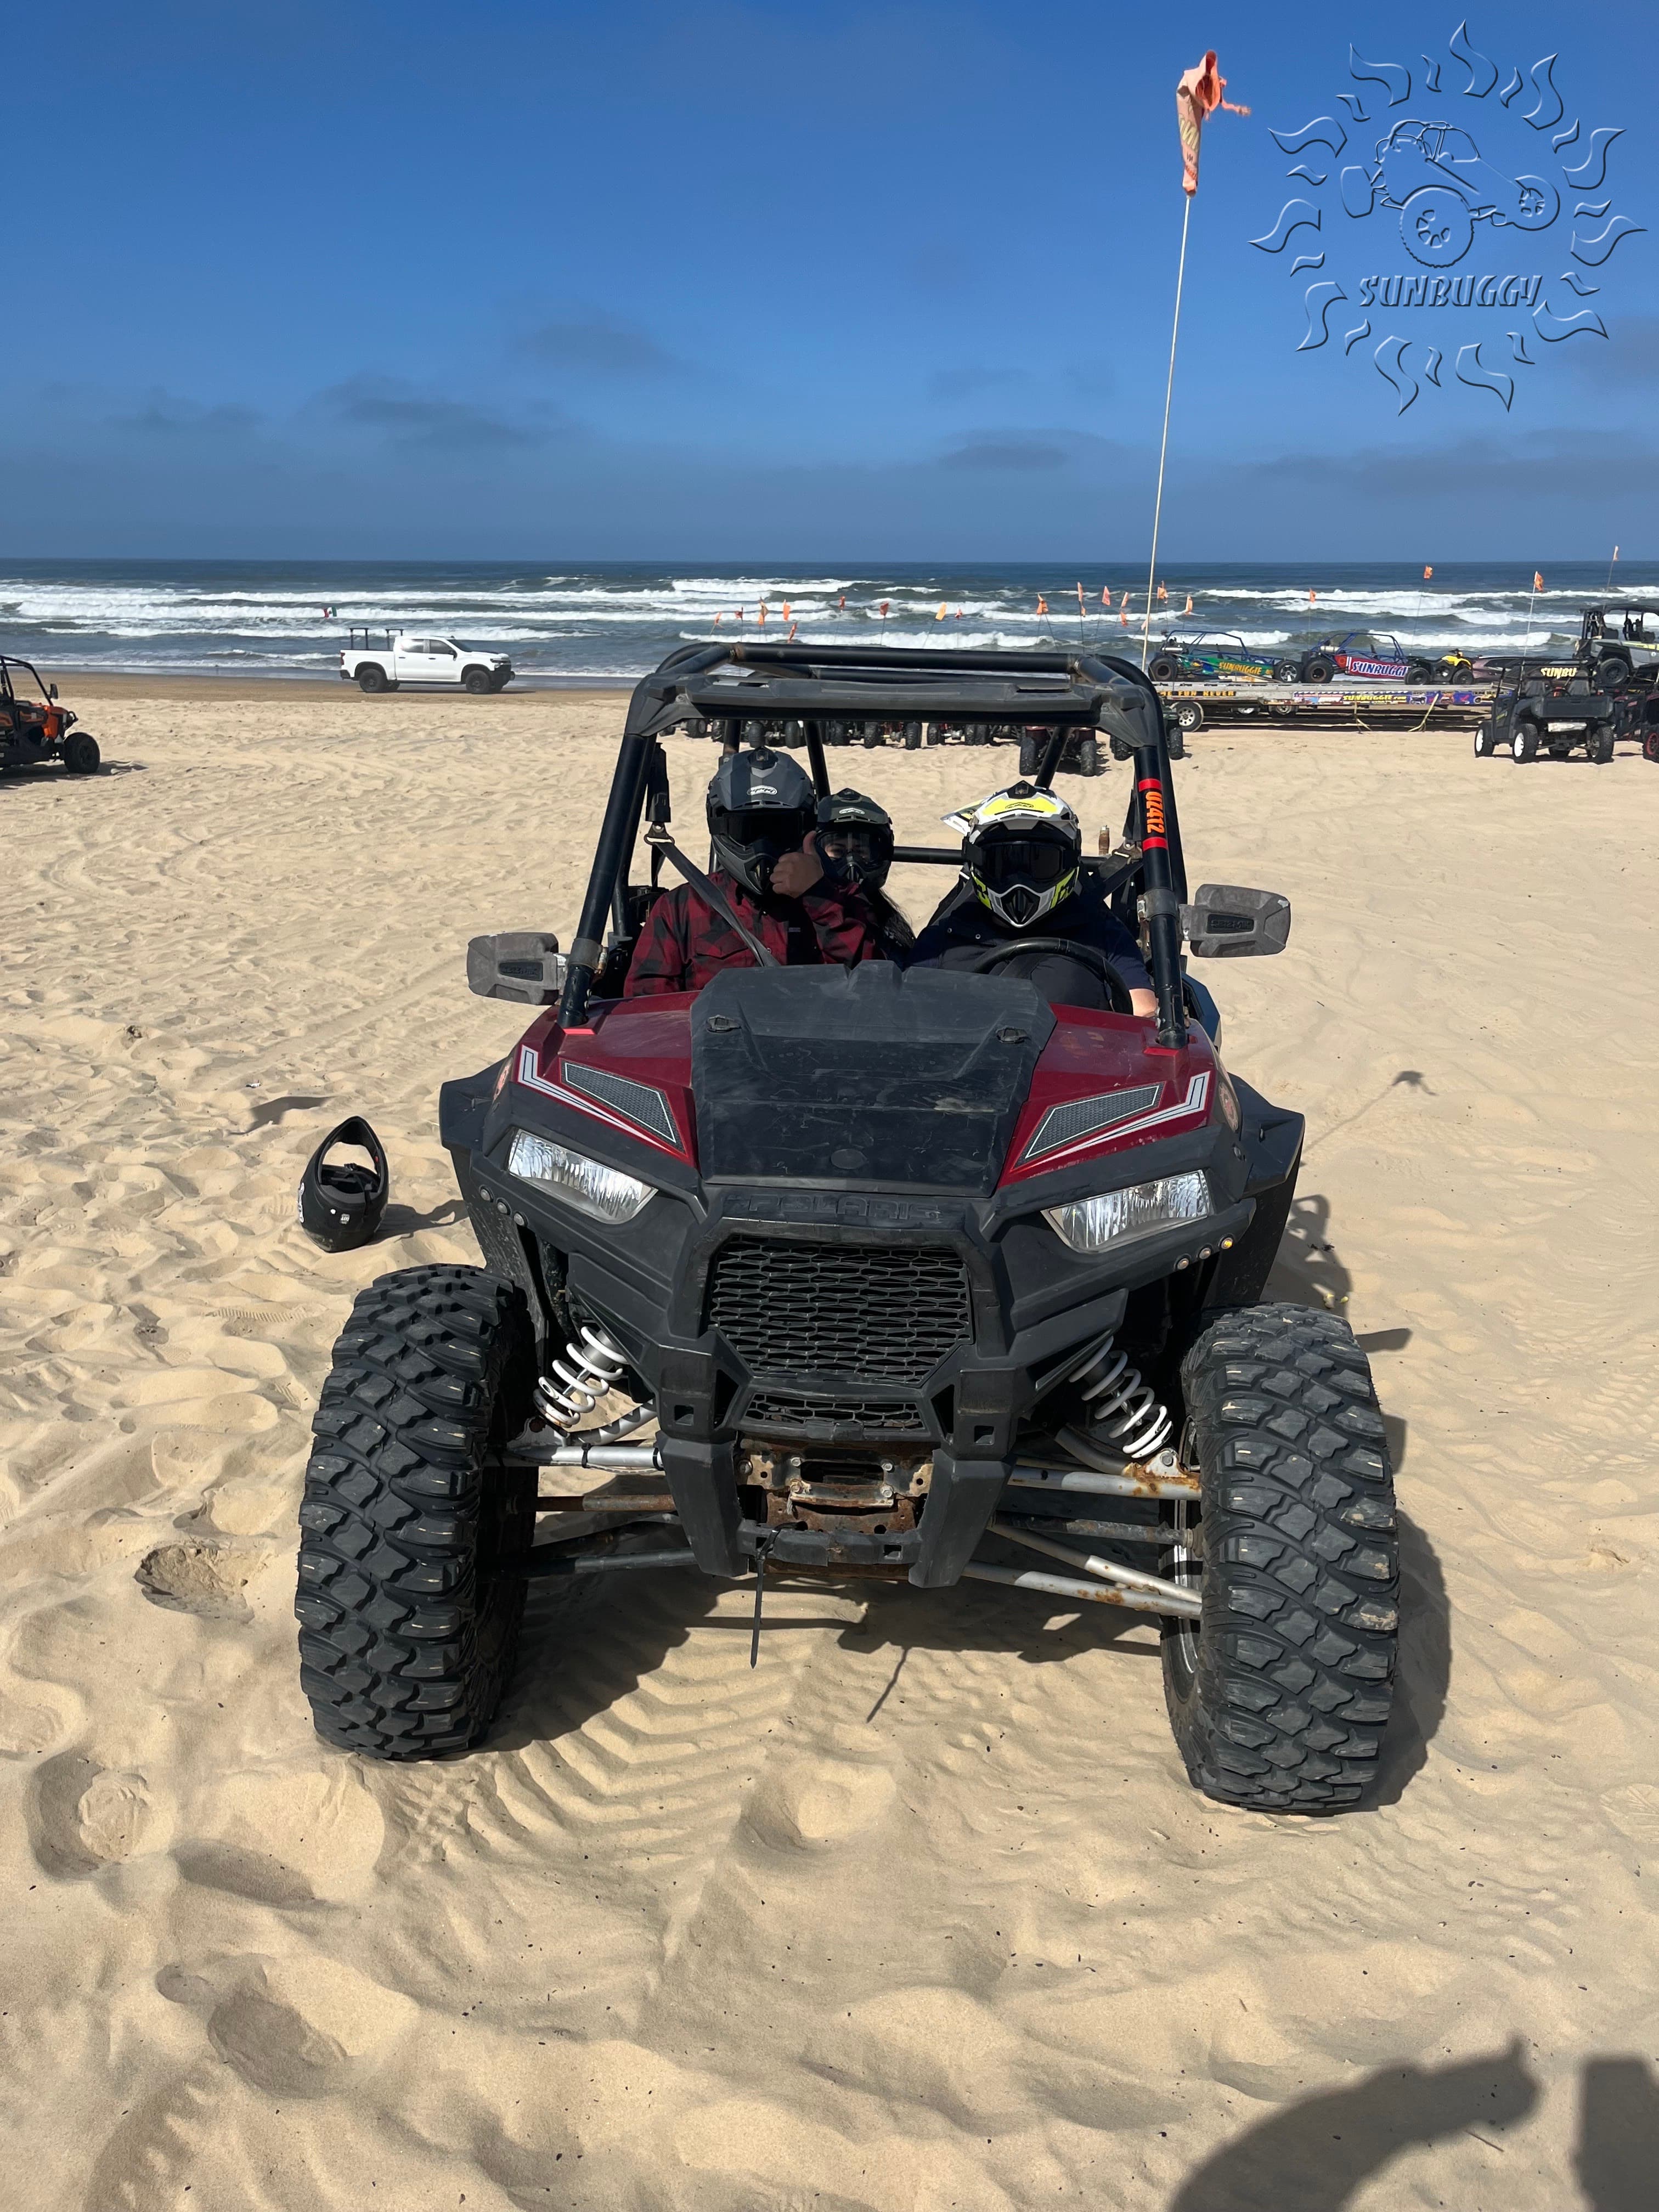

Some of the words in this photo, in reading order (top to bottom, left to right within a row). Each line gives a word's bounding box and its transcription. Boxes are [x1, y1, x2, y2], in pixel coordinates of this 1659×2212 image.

[1351, 661, 1412, 677] SUNBUGGI
[1146, 792, 1165, 833] UZ412
[748, 1194, 941, 1221] POLARIS
